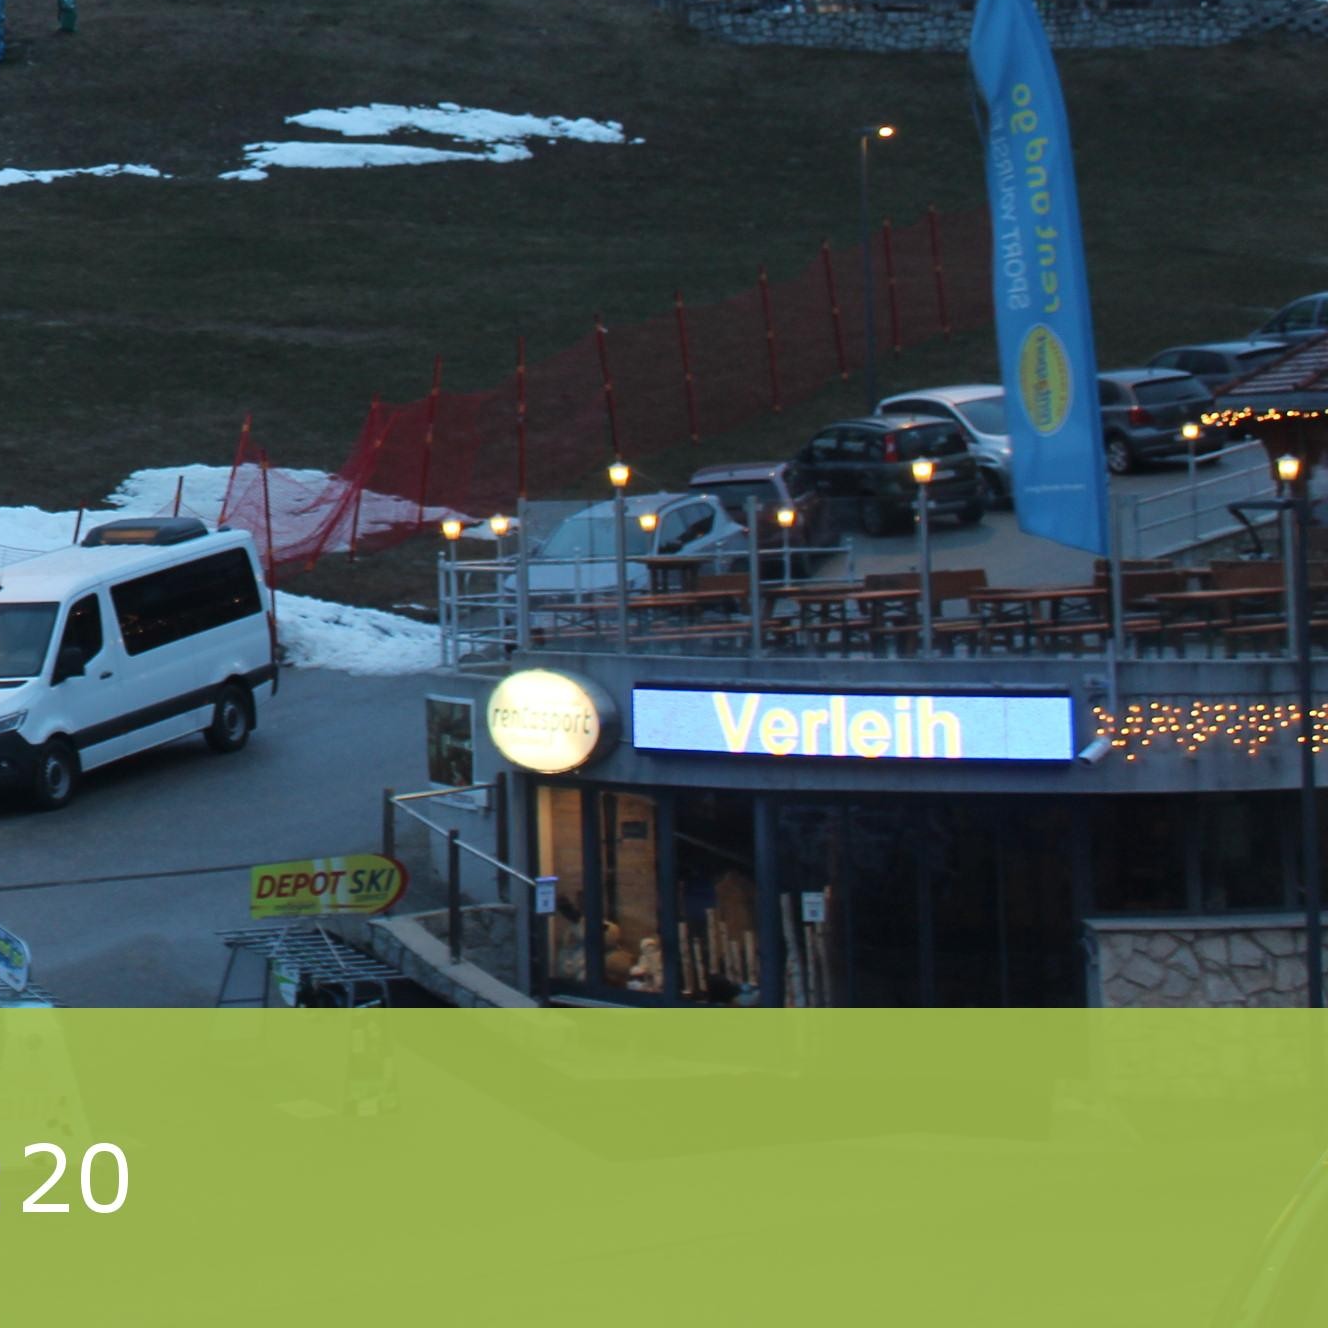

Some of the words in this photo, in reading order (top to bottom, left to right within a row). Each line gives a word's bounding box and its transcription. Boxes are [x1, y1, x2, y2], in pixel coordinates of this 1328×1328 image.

[711, 692, 962, 758] Verleih
[255, 871, 346, 900] DEPOT
[348, 867, 396, 895] SKI
